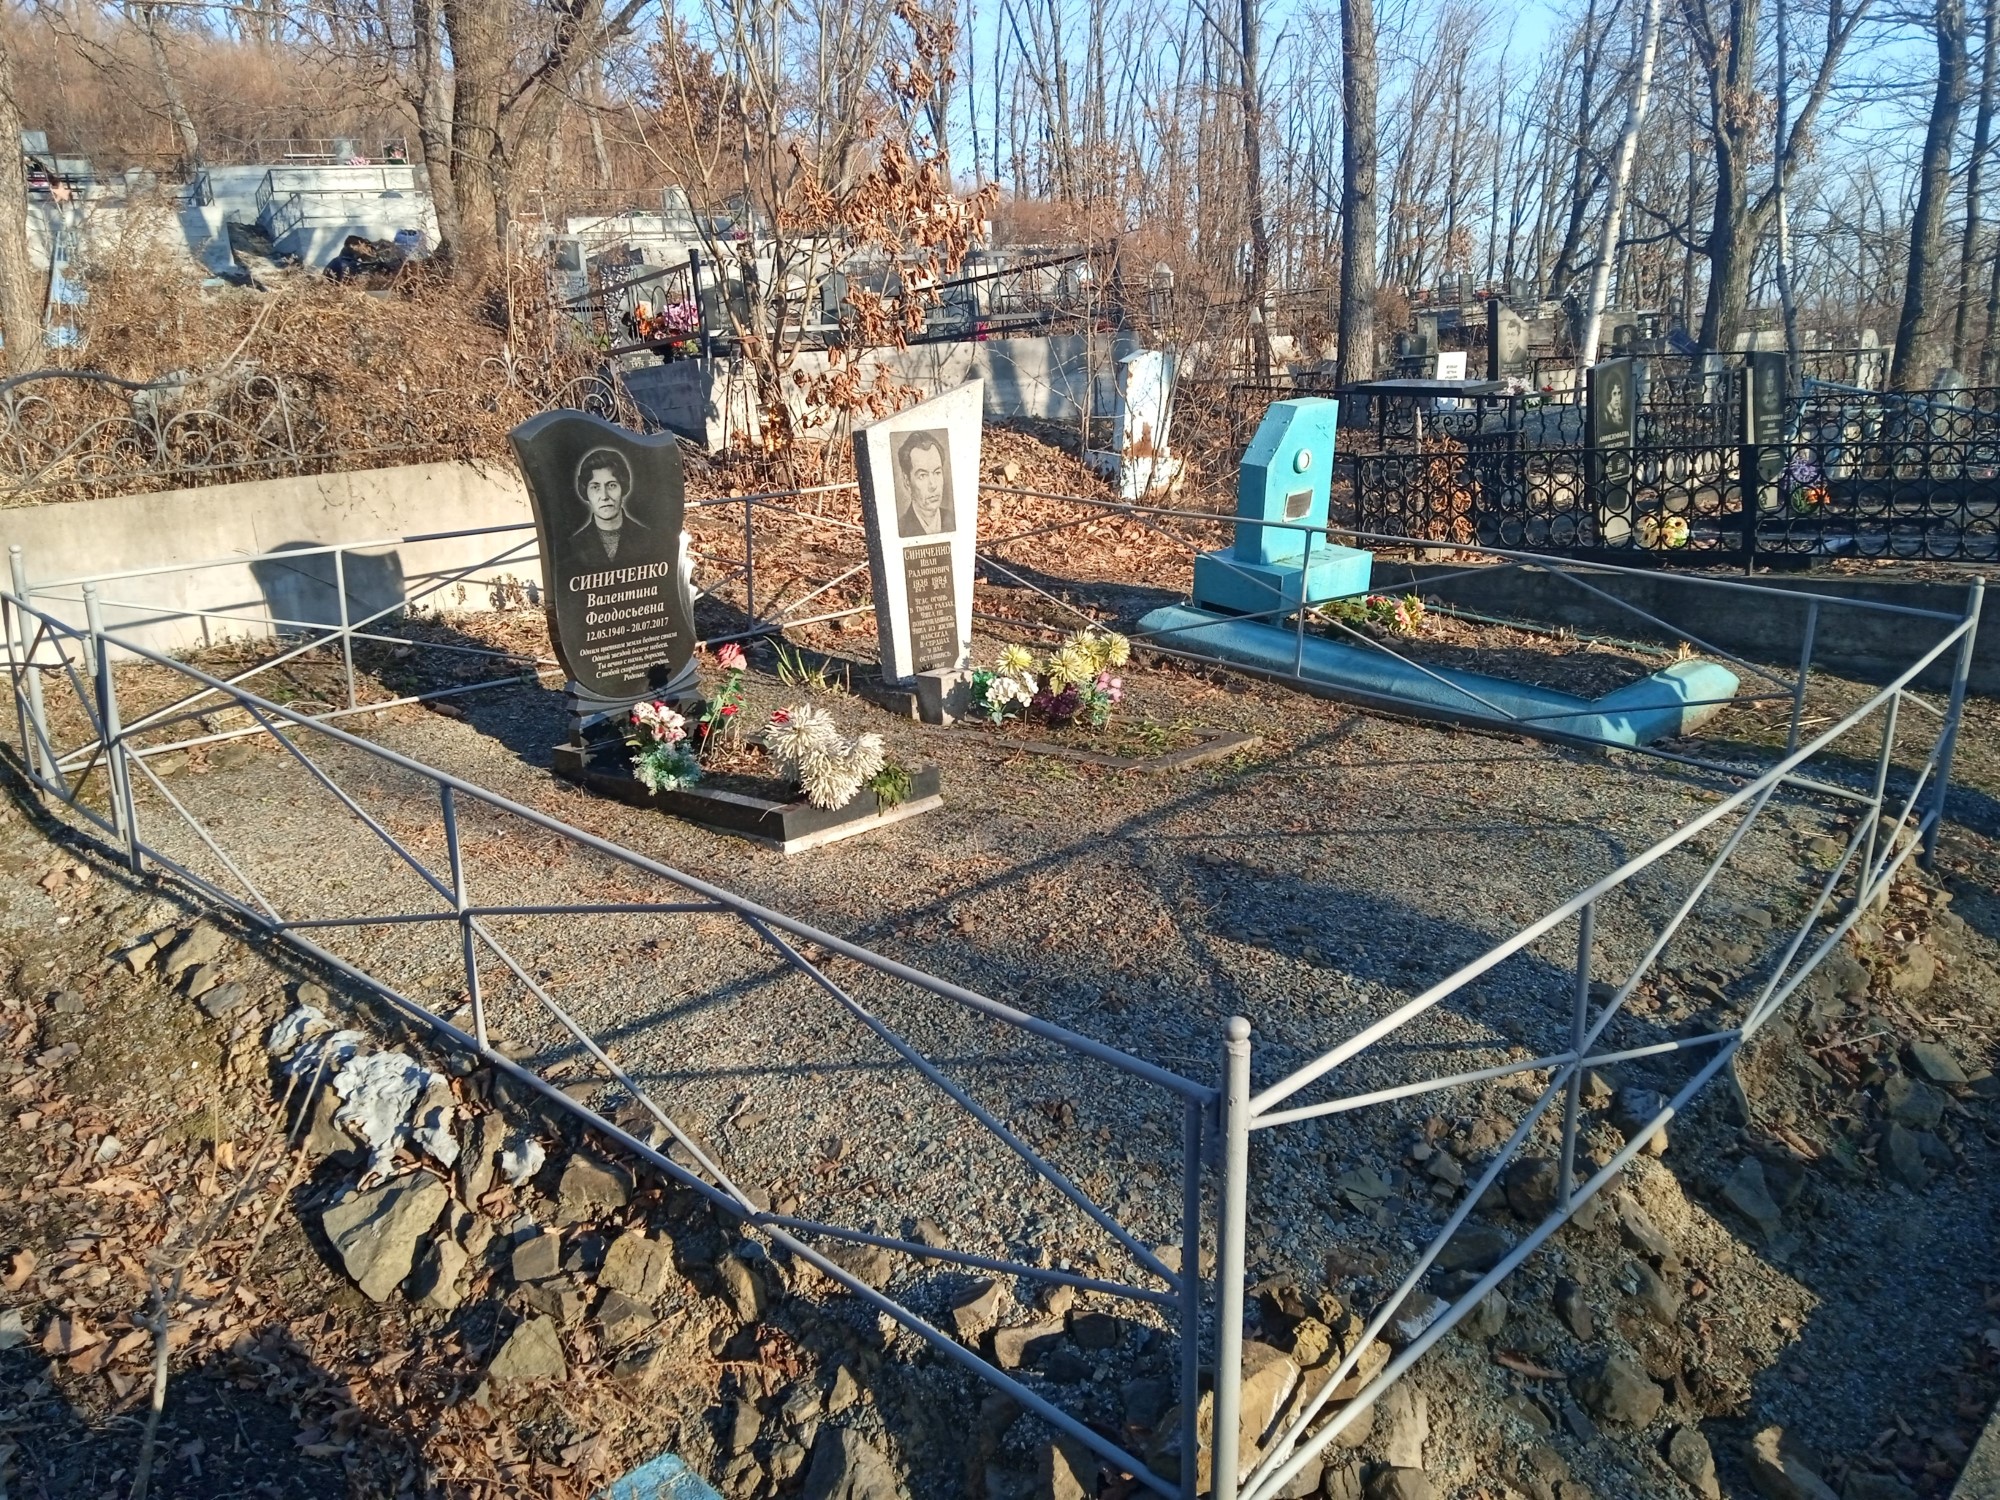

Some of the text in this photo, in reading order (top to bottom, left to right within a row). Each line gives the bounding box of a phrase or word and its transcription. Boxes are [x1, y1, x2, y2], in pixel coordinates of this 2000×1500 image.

[904, 545, 951, 560] СИНИЧЕНКО
[920, 558, 937, 567] ИВАН
[569, 561, 669, 592] СИНИЧЕНКО
[908, 565, 950, 578] РАДИОНОВИЧ
[587, 585, 658, 608] Валентина
[585, 602, 665, 626] Феодосьевна
[586, 625, 626, 642] 12.05.1940
[631, 616, 670, 633] 20.07.2017
[579, 631, 678, 657] Одним цветком земля беднее стала
[925, 637, 951, 647] СЕРДЦАХ
[592, 653, 610, 663] Одной
[611, 648, 631, 659] звездой
[631, 646, 649, 655] богаче
[595, 671, 601, 679] С
[601, 667, 620, 678] тобой
[620, 661, 651, 674] скорбящие
[597, 661, 607, 670] Ты
[607, 659, 623, 668] вечно
[623, 671, 646, 682] Родные.
